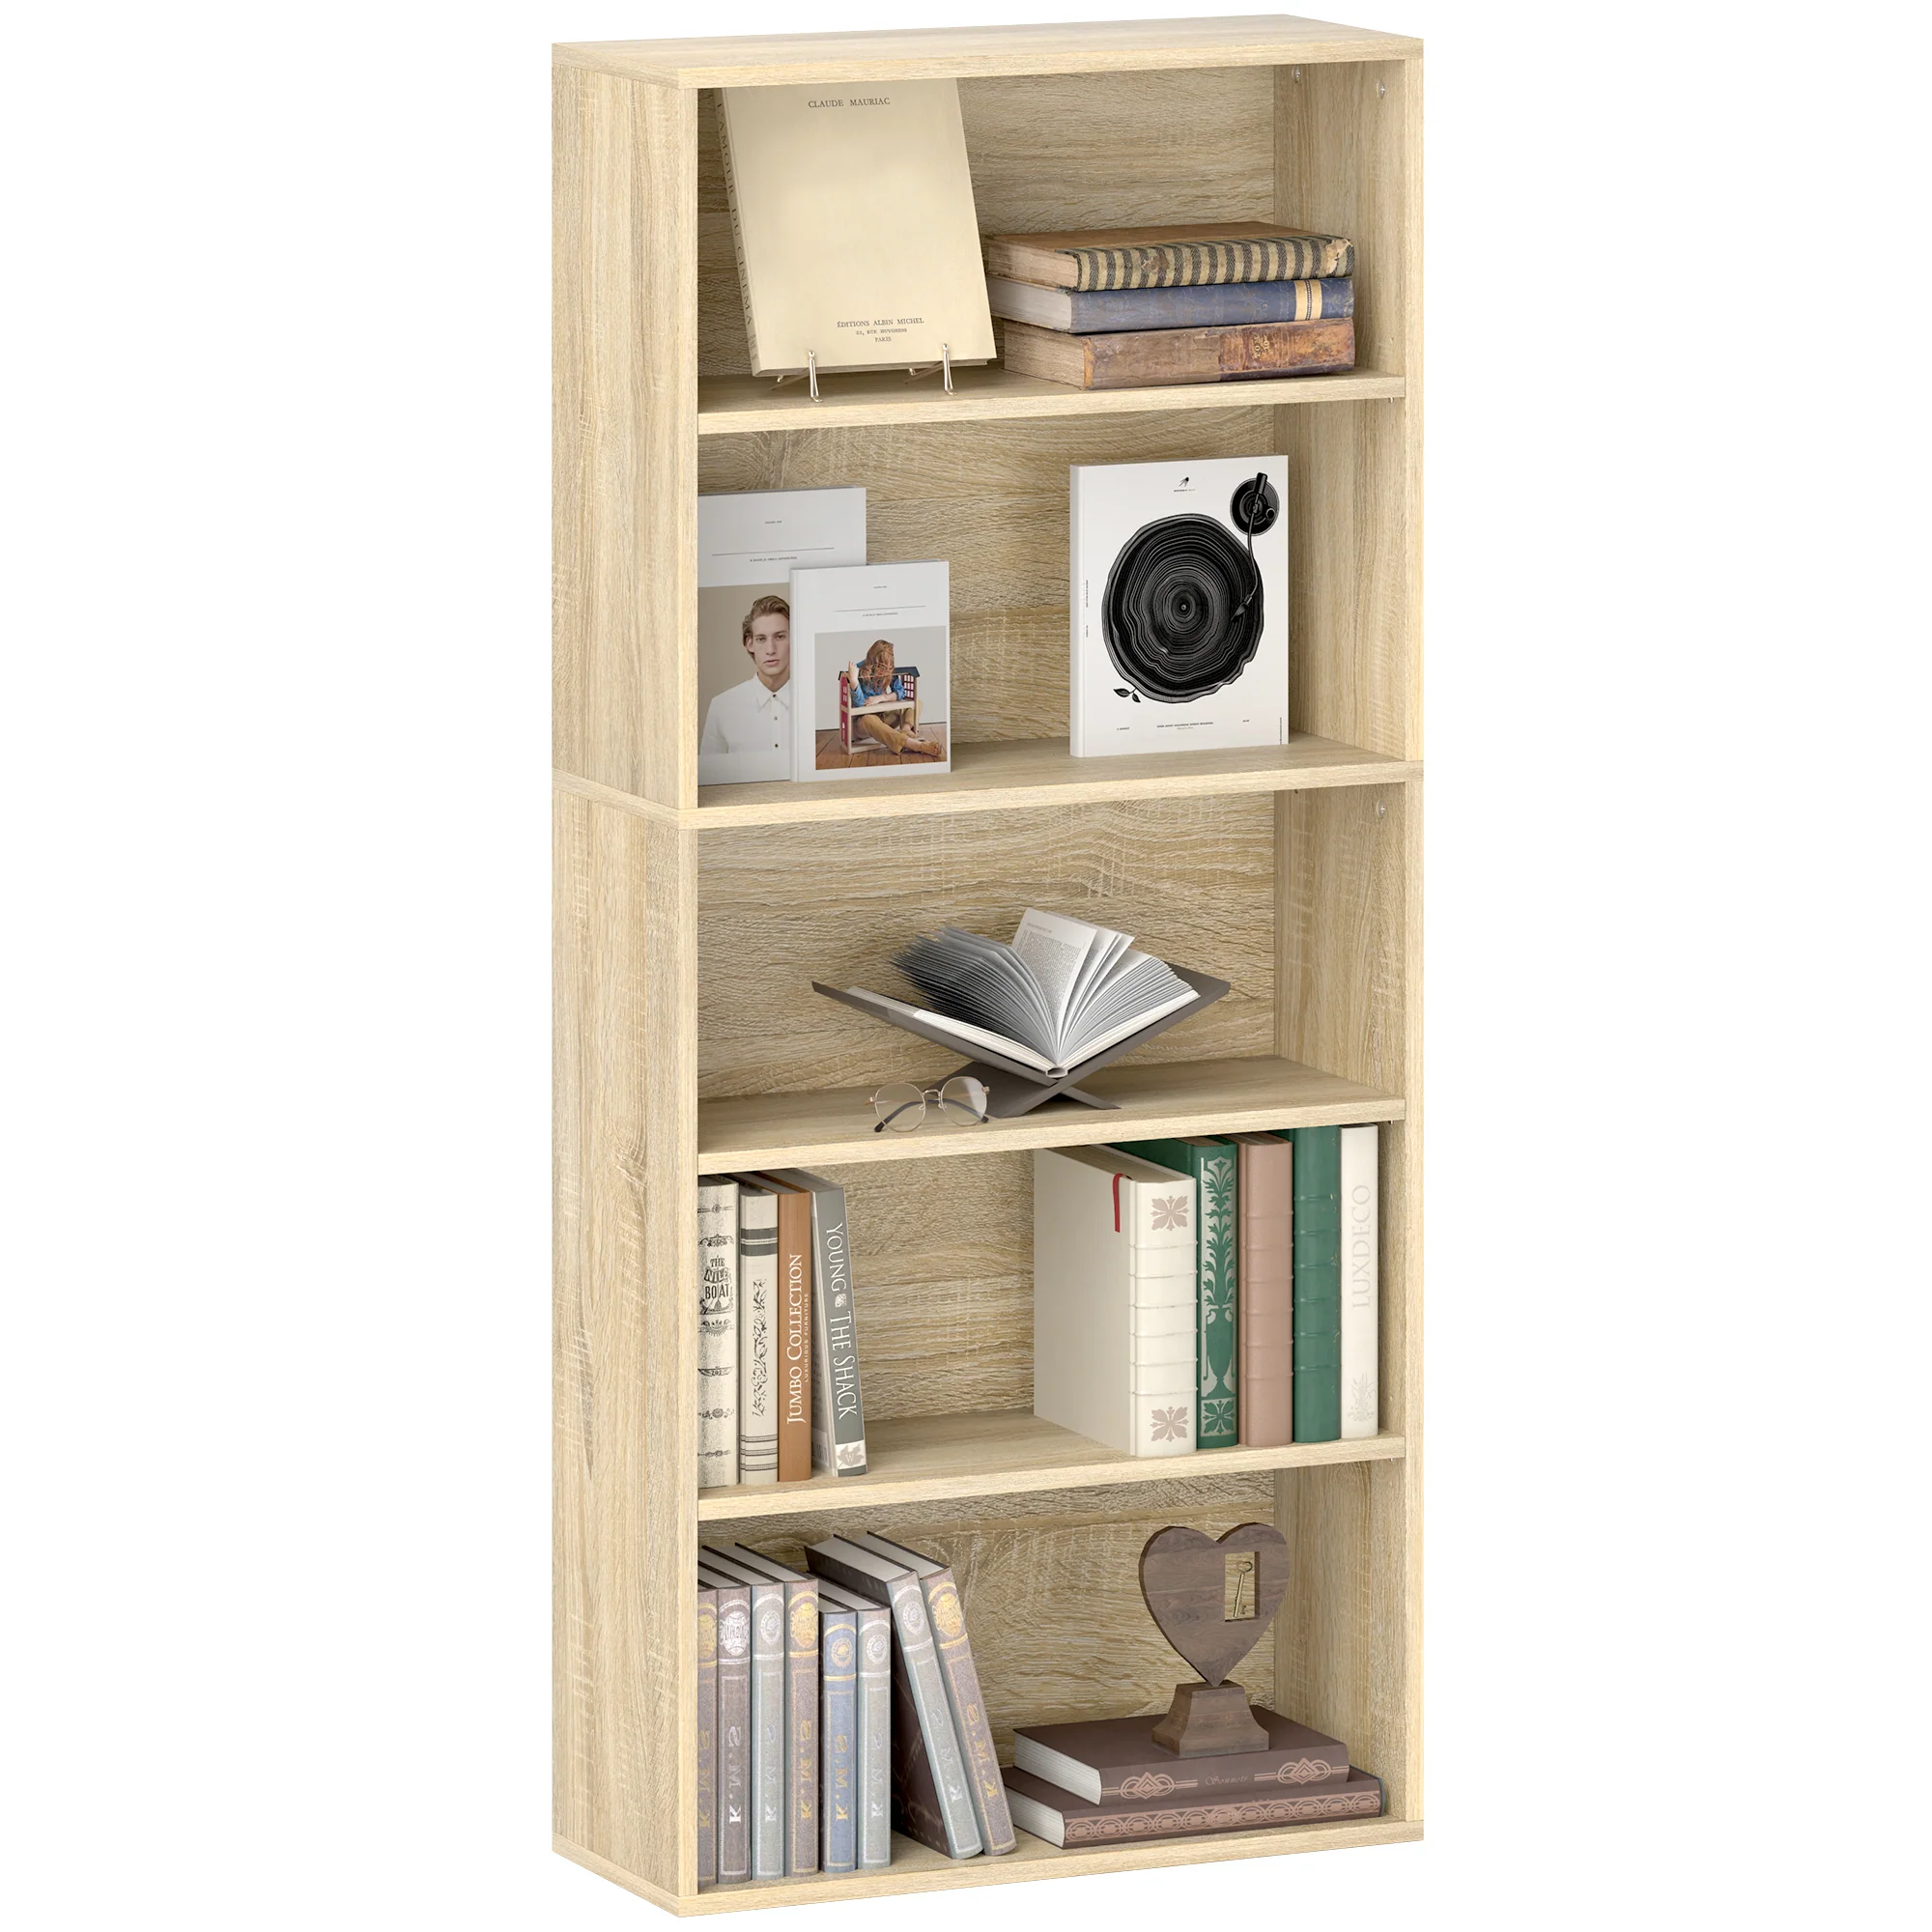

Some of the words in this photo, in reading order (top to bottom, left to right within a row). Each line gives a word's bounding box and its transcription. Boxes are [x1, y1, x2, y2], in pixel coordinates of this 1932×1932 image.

[808, 99, 844, 108] CLAUDE
[849, 98, 891, 106] MAURIAC
[731, 209, 741, 237] DU
[710, 1257, 725, 1267] THE
[826, 1222, 847, 1292] YOUNG
[1351, 1184, 1372, 1308] LUXDECO
[786, 1254, 803, 1361] COLLECTION
[830, 1311, 852, 1351] THE
[787, 1367, 807, 1425] JUMBO
[833, 1355, 858, 1420] SHACK
